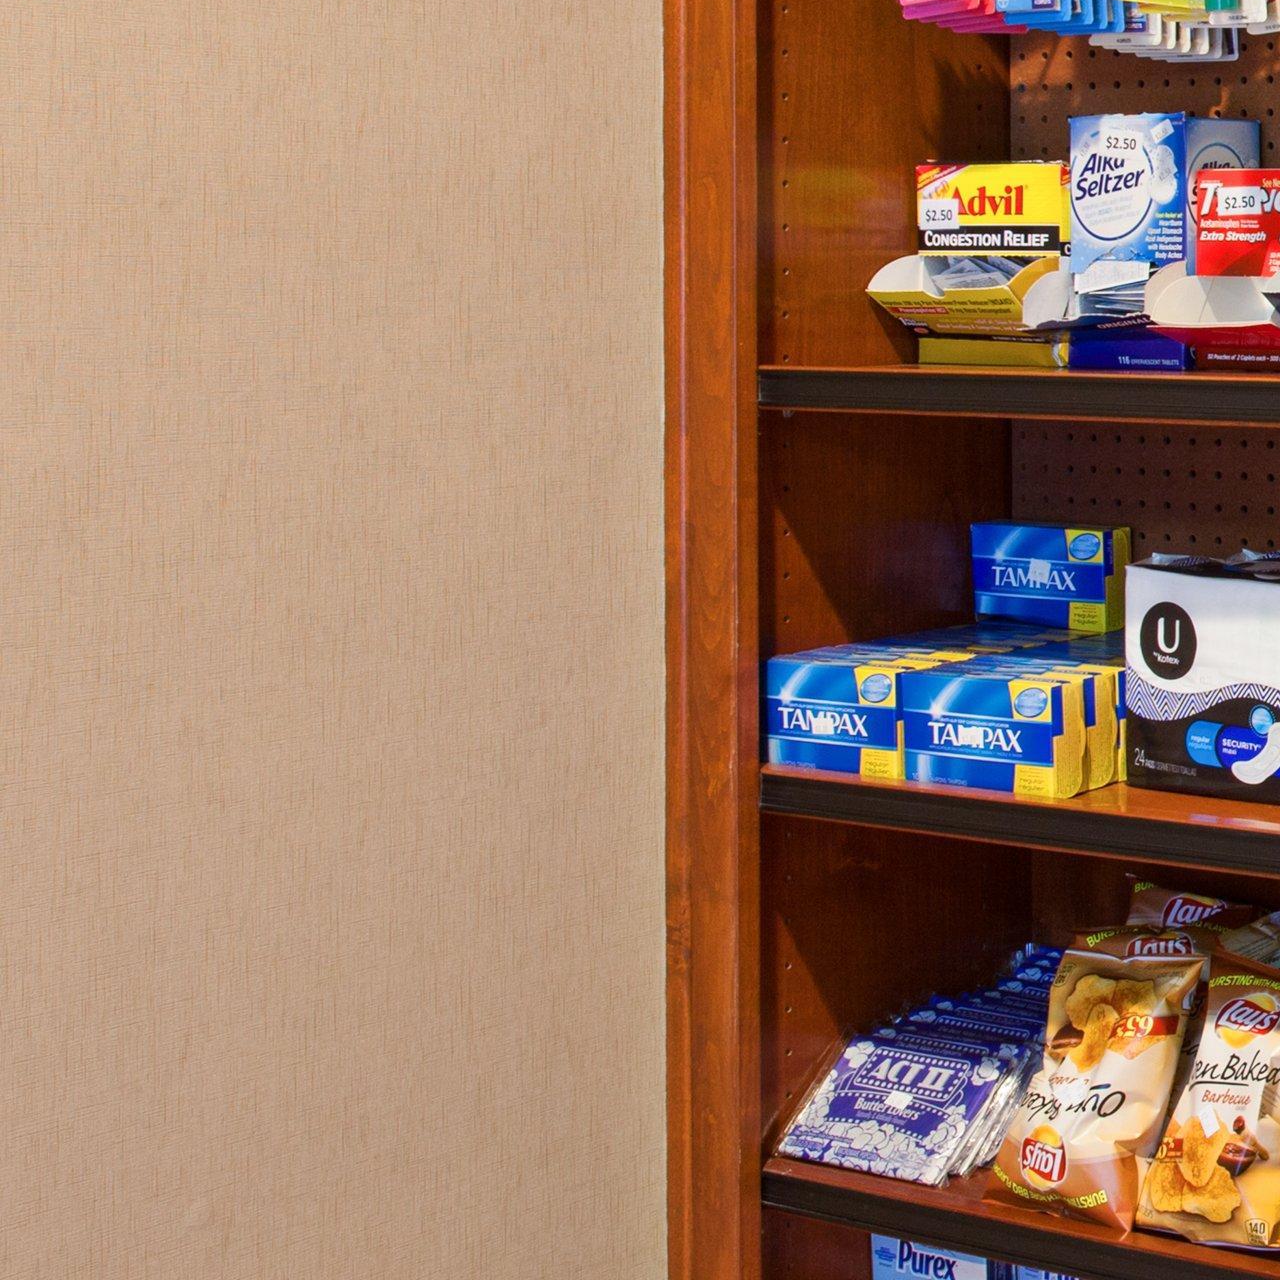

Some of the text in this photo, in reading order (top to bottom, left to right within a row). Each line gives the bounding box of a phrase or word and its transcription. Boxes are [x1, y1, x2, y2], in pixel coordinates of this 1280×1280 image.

[1106, 137, 1137, 150] $2.50
[1075, 169, 1145, 201] Seltzer
[1263, 178, 1272, 187] See
[951, 184, 1024, 216] Advil
[1224, 195, 1255, 210] $2.50
[925, 209, 953, 222] $2.50
[924, 230, 1049, 247] CONGESTION RELIEF
[1200, 231, 1266, 243] Extra Strength
[992, 566, 1076, 591] TAMAX
[1157, 617, 1180, 654] U
[928, 722, 1023, 753] TAPAX
[1222, 738, 1259, 750] SECURITY
[1134, 748, 1145, 765] 24
[1218, 1001, 1278, 1031] Lay's
[868, 1058, 926, 1086] ACT
[854, 1097, 892, 1114] Butter
[1202, 1089, 1252, 1105] Barbecue
[899, 1240, 956, 1280] Purex
